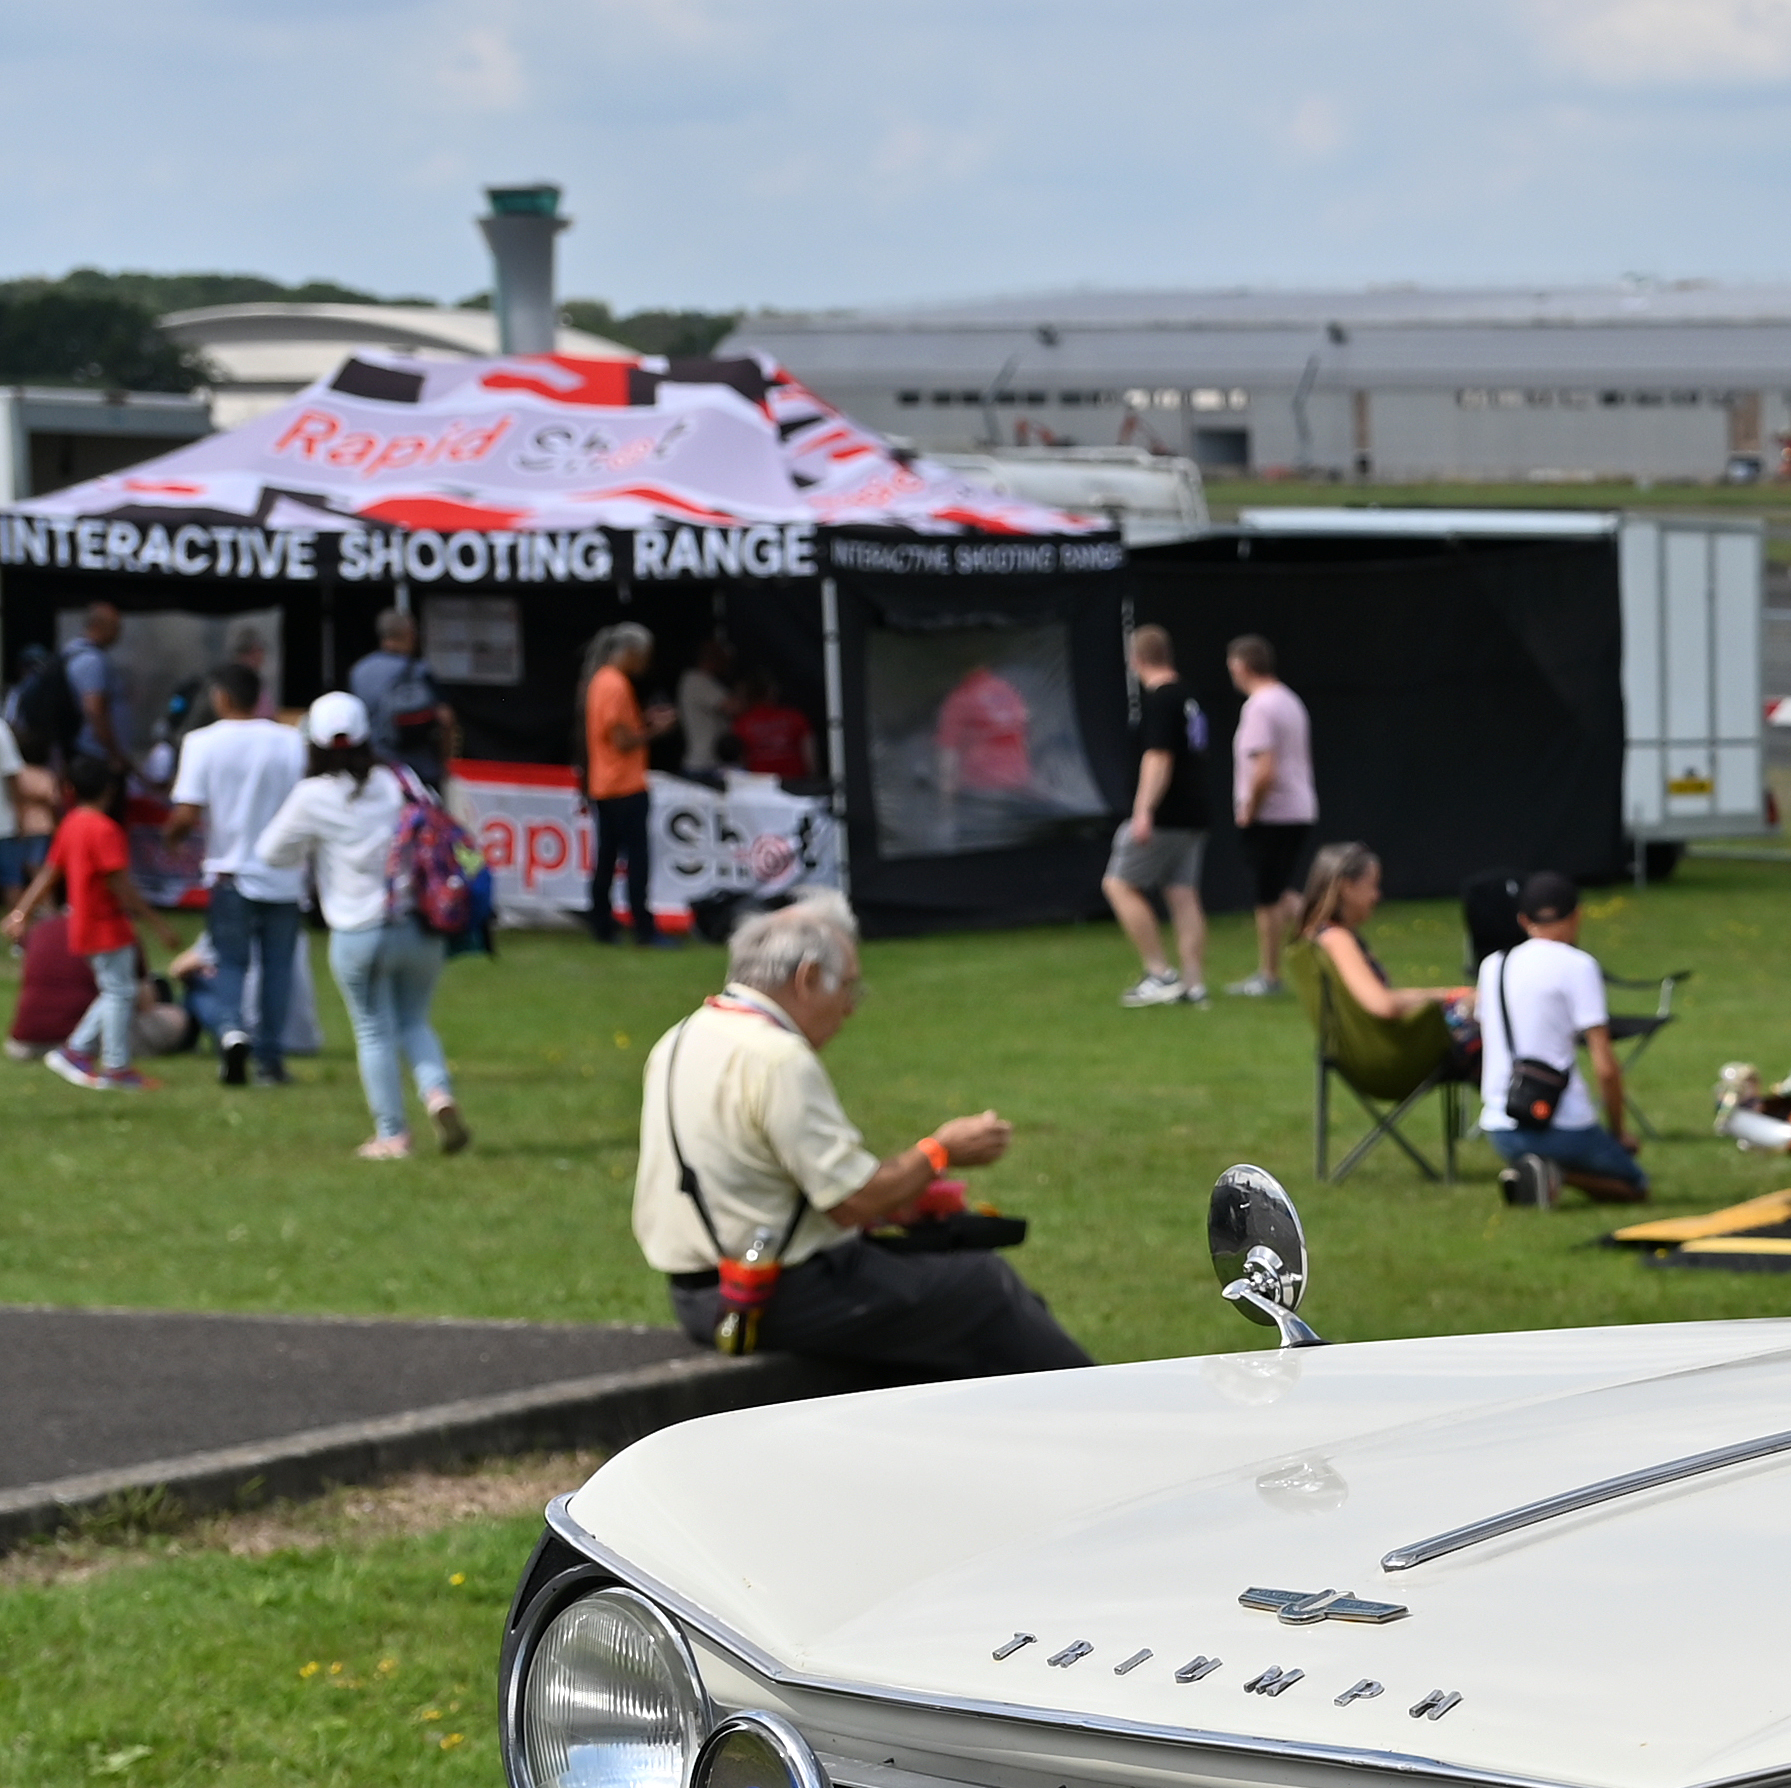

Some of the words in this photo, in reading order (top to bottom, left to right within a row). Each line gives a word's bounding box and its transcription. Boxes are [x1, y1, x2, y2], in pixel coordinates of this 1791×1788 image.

[275, 410, 513, 475] Rapid
[0, 515, 318, 581] INTERACTIVE
[337, 527, 614, 583] SHOOTING
[632, 522, 819, 578] RANGE
[992, 1631, 1464, 1721] TRIUMPH
